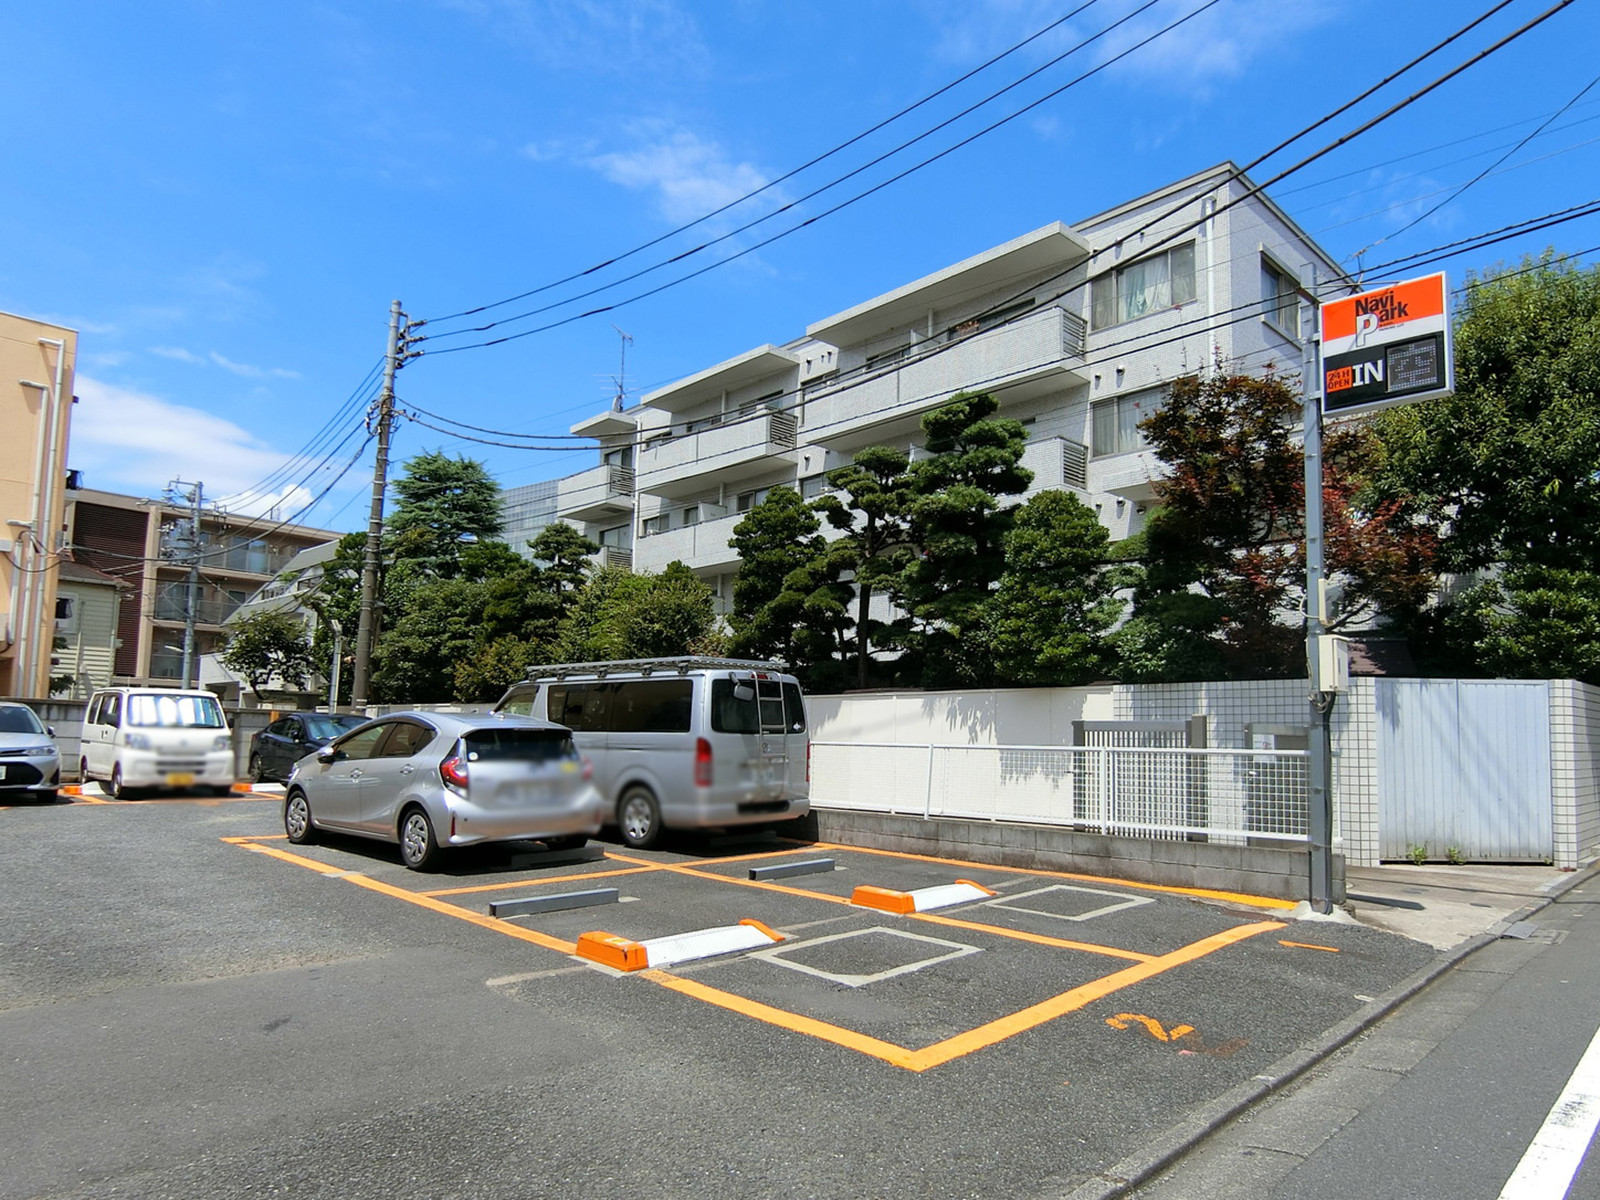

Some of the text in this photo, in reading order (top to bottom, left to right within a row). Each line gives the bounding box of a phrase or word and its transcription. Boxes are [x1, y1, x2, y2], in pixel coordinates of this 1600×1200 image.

[1356, 292, 1394, 315] Navi
[1356, 302, 1408, 347] Park
[1353, 360, 1383, 387] IN
[1389, 345, 1437, 390] 空
[1328, 378, 1349, 389] OPEN
